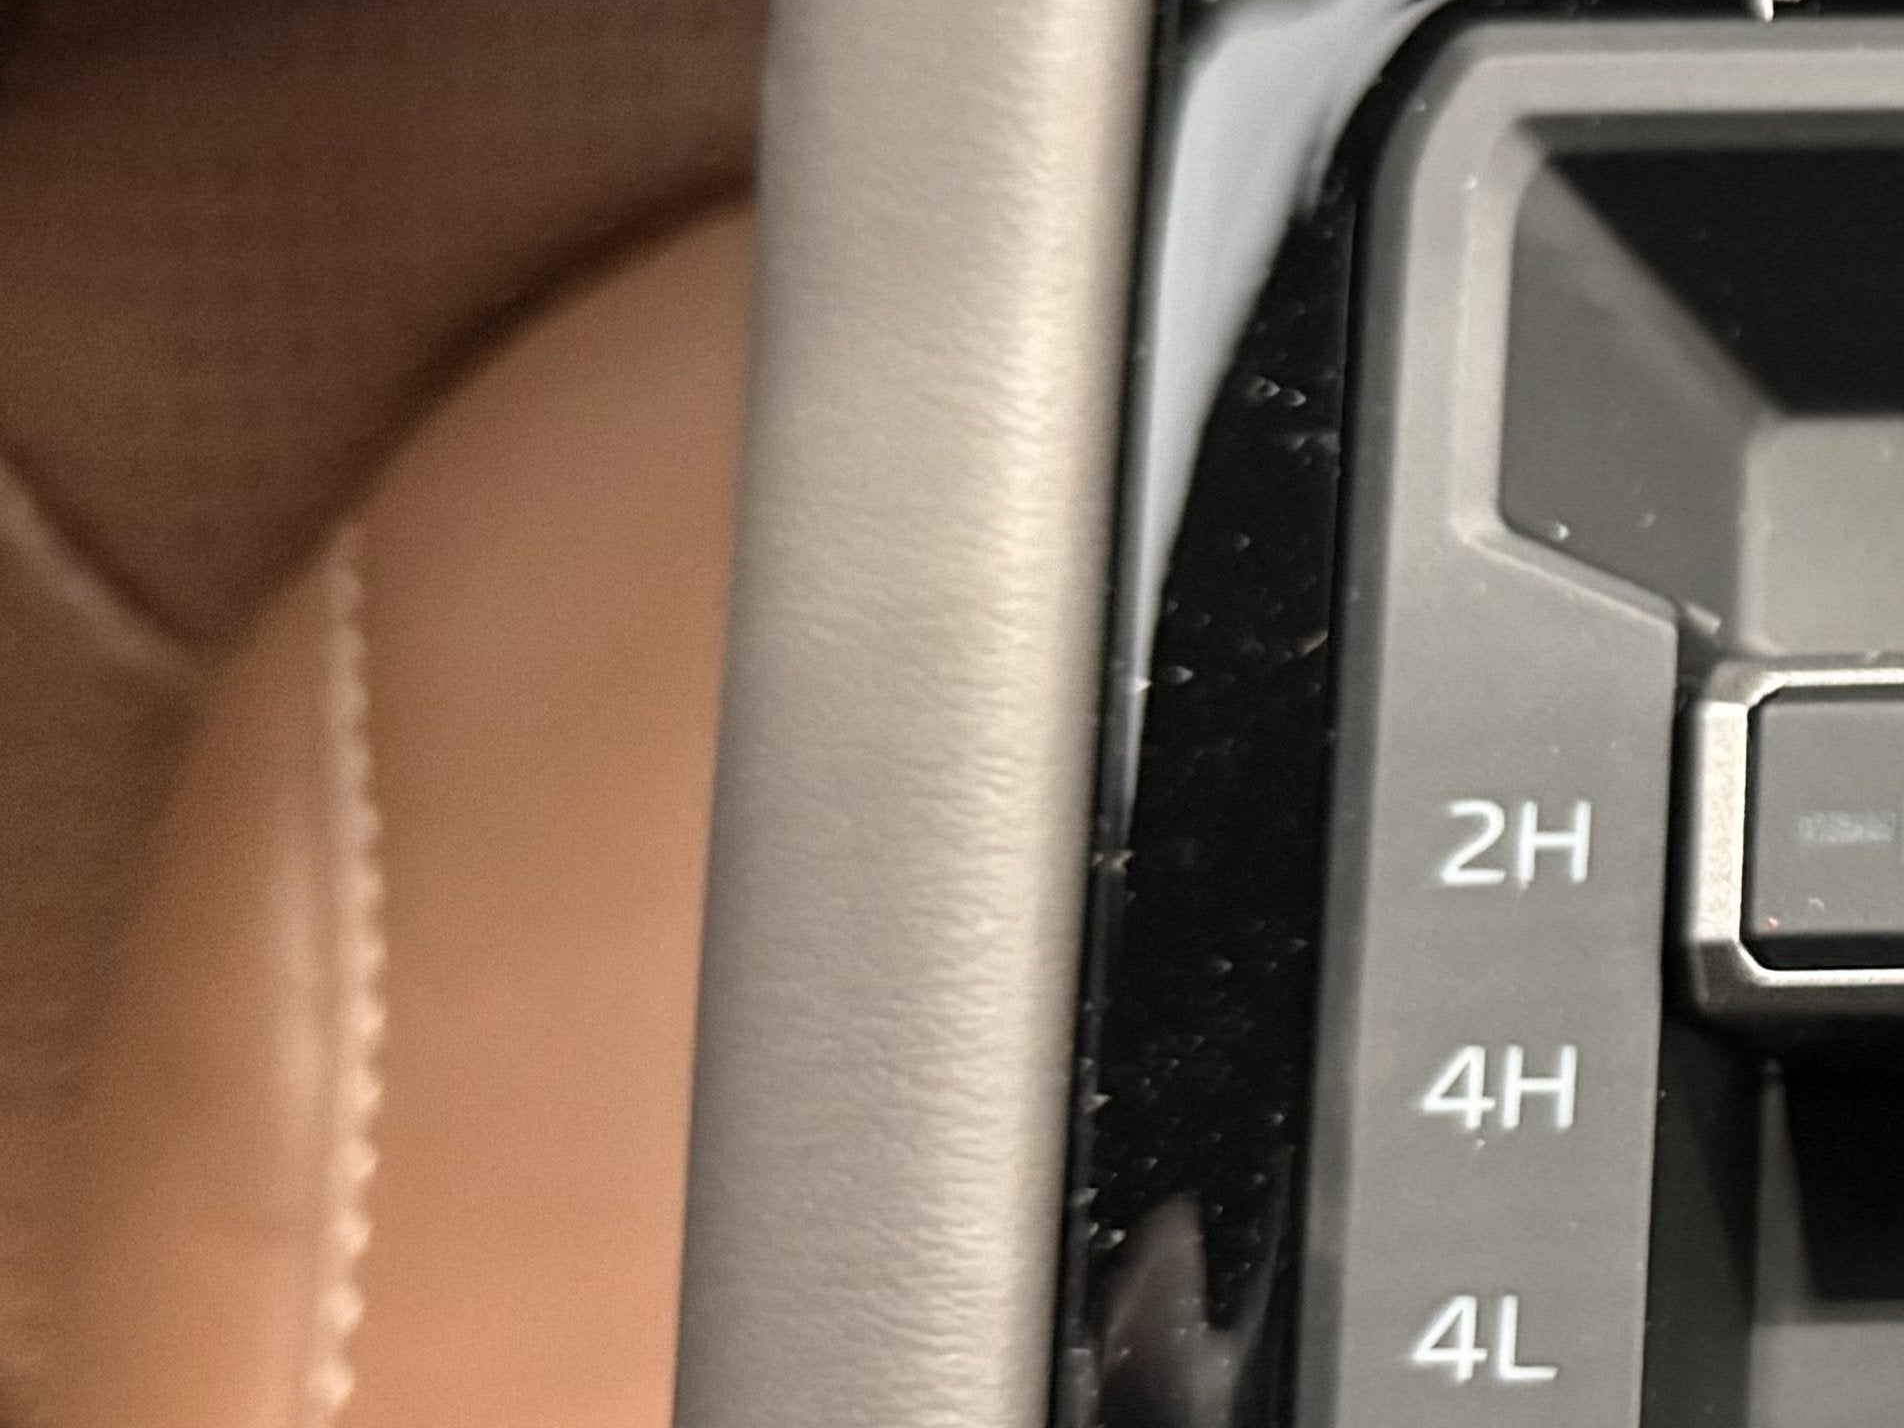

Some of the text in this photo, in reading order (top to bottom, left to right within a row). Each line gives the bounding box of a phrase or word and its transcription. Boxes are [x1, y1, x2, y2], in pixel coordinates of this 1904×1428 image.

[1438, 799, 1592, 888] 2H
[1417, 1044, 1578, 1132] 4H
[1408, 1294, 1558, 1384] 4L
